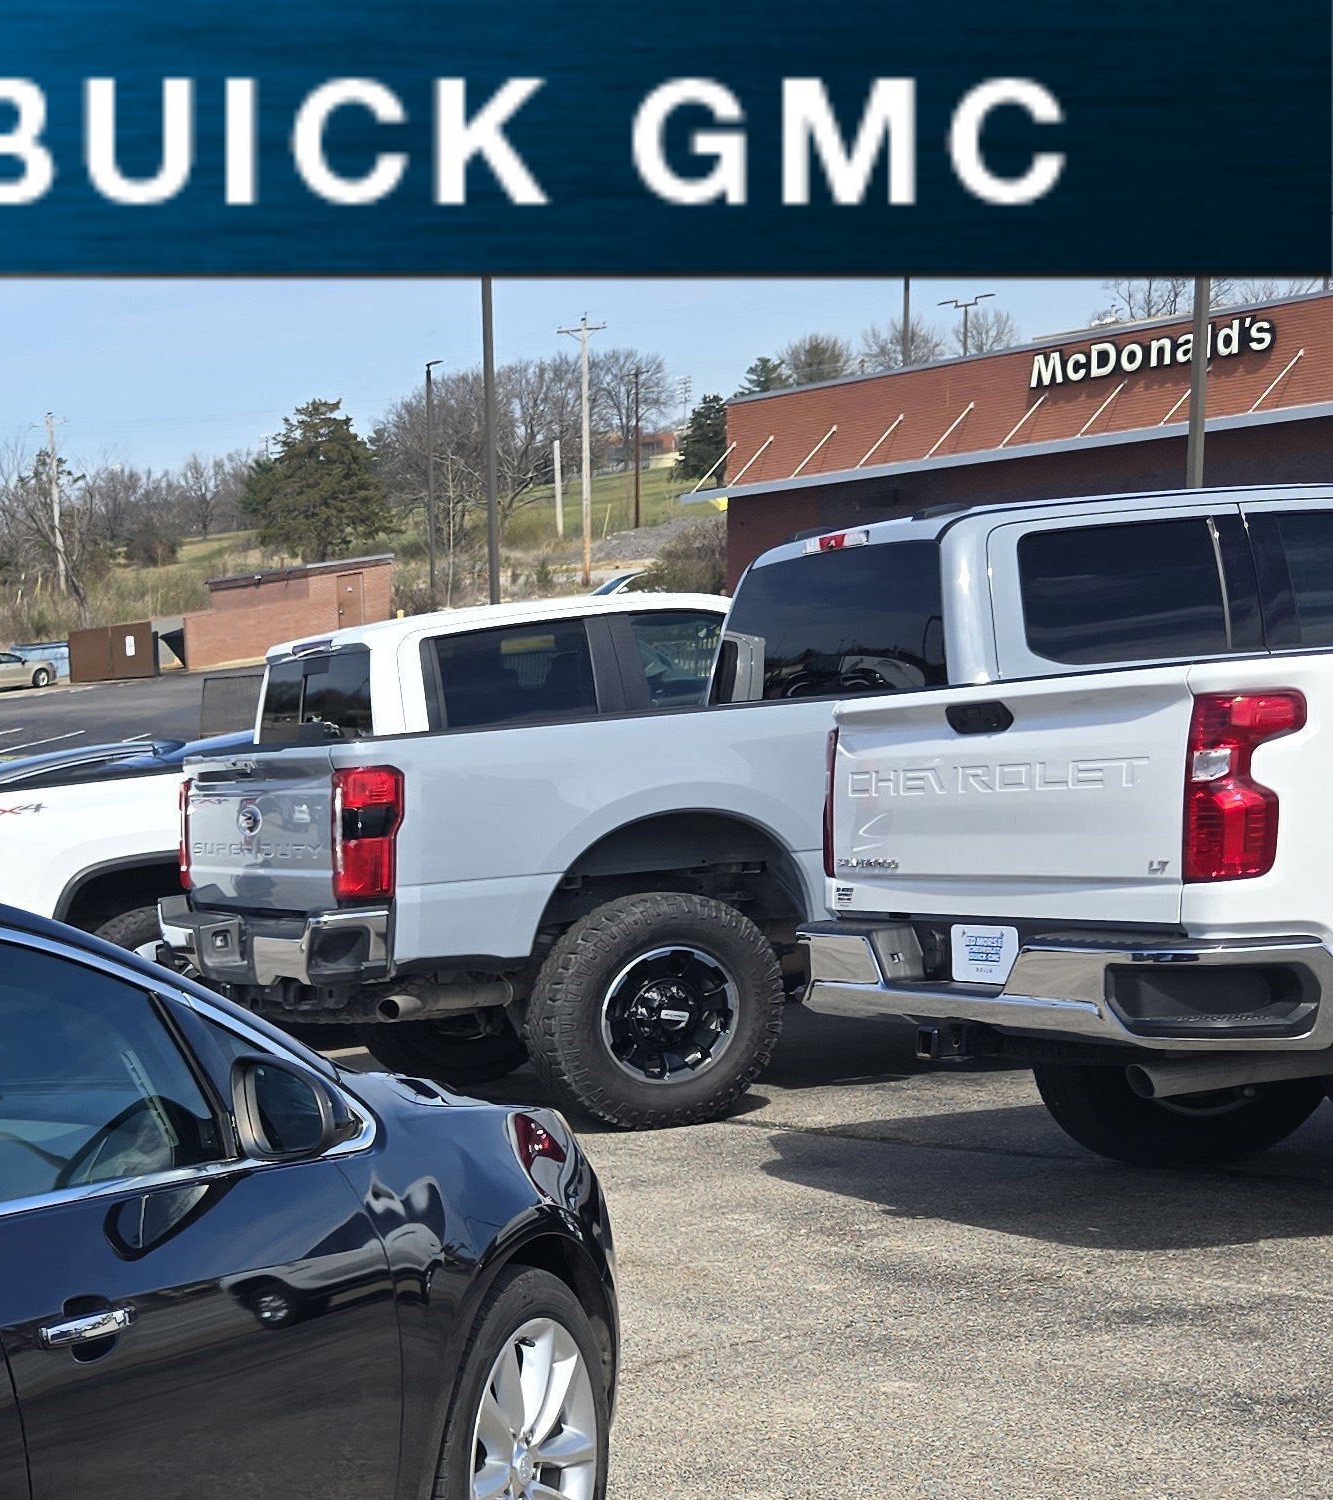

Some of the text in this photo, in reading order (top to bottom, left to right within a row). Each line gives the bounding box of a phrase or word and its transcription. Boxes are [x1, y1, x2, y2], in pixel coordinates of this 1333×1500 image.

[1029, 317, 1273, 388] McDonald's
[848, 756, 1150, 797] CHEVROLET
[193, 842, 323, 859] SUPER DUTY
[1147, 859, 1169, 875] LT
